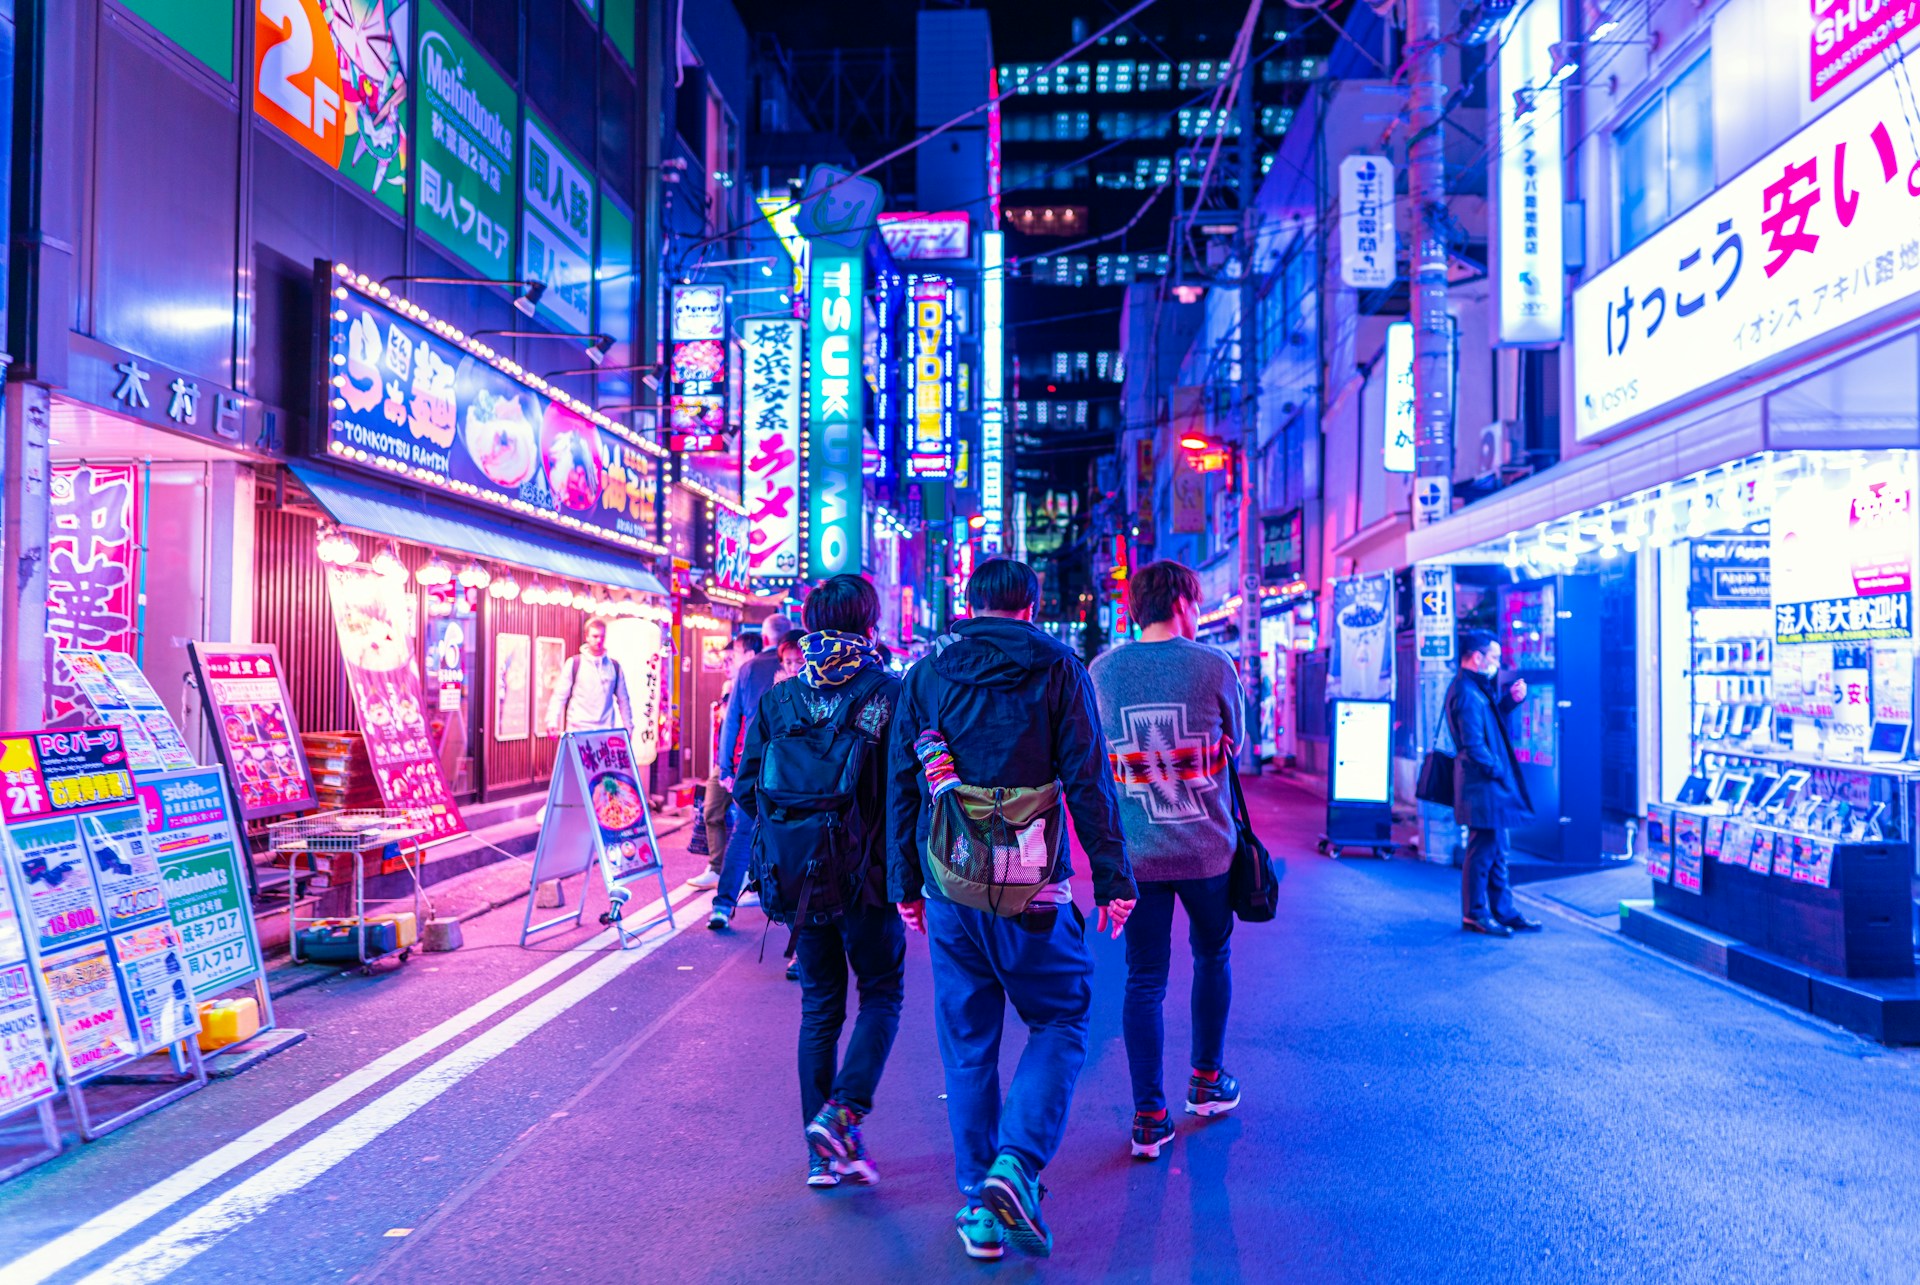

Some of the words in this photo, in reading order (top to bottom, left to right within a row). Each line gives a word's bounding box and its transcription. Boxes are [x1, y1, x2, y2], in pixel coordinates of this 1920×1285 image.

[1815, 0, 1890, 56] SHO
[259, 0, 340, 139] 2F
[427, 43, 512, 161] Melonbooks
[421, 159, 509, 259] 同人フロア
[115, 360, 283, 451] 木村ビル
[683, 381, 713, 395] 2F
[821, 262, 852, 572] TSUKUMO
[345, 420, 410, 460] TONKOTSU
[684, 436, 713, 450] 2F
[747, 433, 796, 569] ラーメン
[38, 731, 119, 758] PCパーツ
[6, 784, 43, 815] 2F
